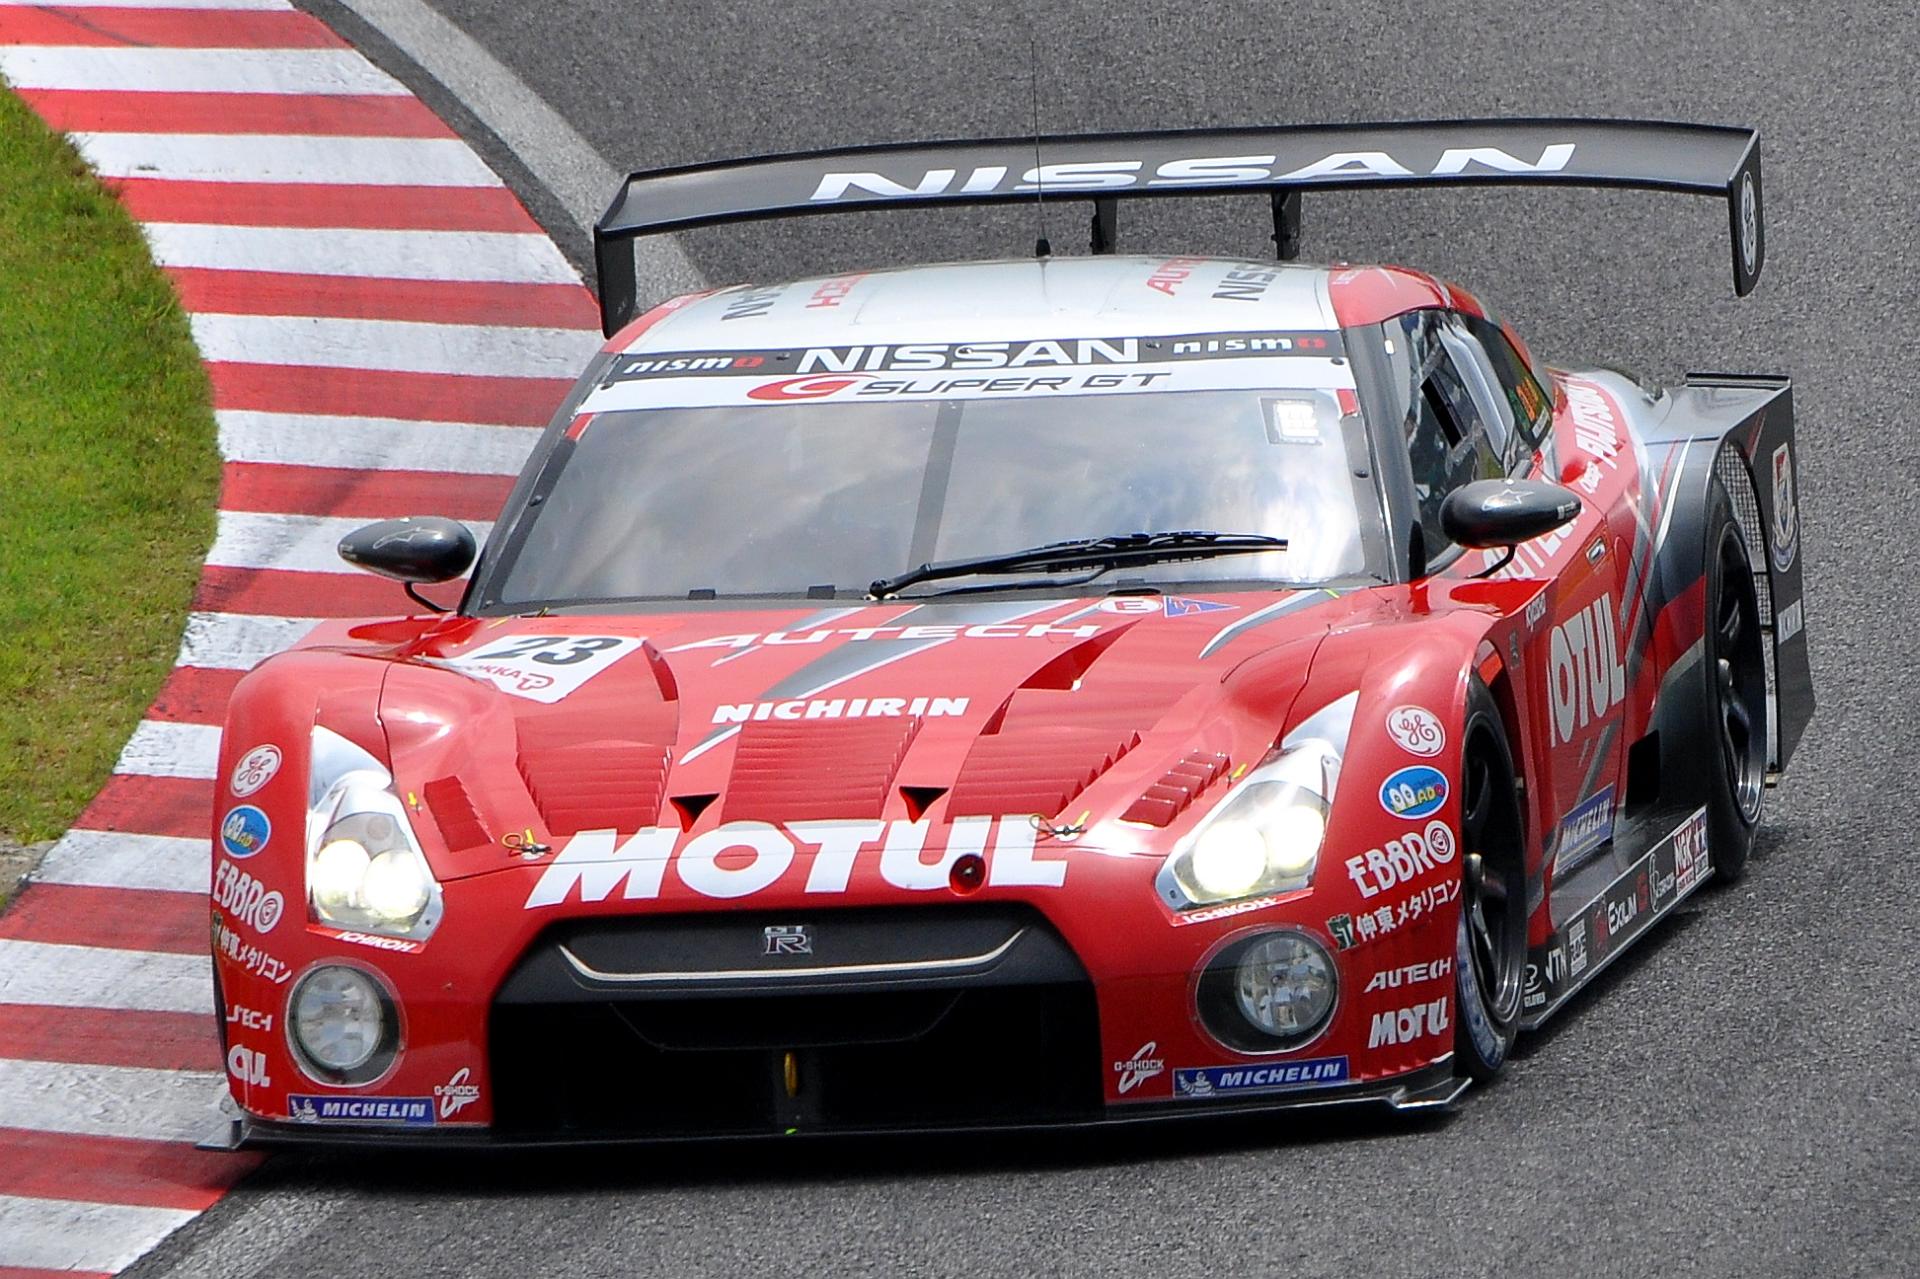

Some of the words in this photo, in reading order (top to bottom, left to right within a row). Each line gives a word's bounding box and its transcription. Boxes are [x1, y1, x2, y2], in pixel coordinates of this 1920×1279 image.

[810, 142, 1575, 200] NISSAN
[795, 337, 1140, 374] NISSAN
[1173, 337, 1327, 355] nismo
[623, 356, 765, 374] nismo
[856, 375, 1072, 396] SUPER
[1080, 372, 1172, 390] GT
[472, 637, 623, 665] 23
[664, 625, 1100, 653] AUTECH
[1547, 591, 1626, 749] OTUL
[711, 697, 970, 724] NICHIRIN
[523, 814, 1068, 910] MOTUL
[335, 931, 417, 953] ICHIKOH
[1363, 957, 1452, 993] AUTECH
[1368, 996, 1449, 1049] MOTUL
[1219, 1062, 1341, 1088] MICHELIN
[322, 1101, 426, 1118] MICHELIN
